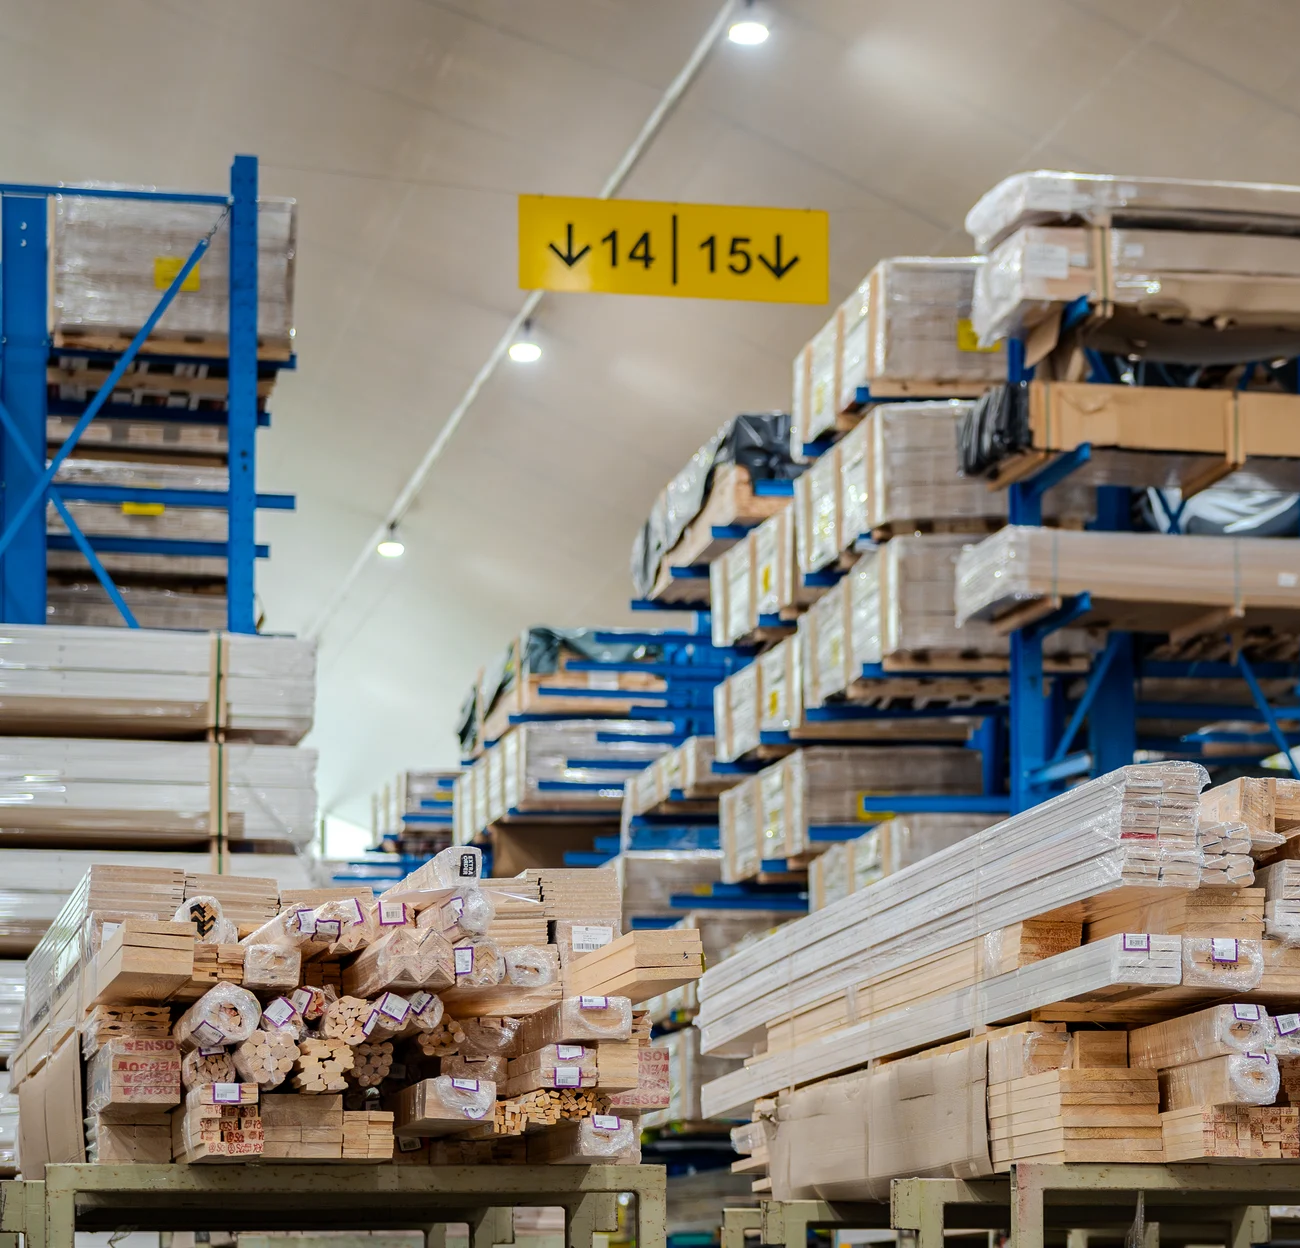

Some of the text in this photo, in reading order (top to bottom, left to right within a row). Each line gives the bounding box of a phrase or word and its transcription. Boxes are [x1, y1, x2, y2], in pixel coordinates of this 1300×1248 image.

[601, 229, 752, 275] 14 15
[135, 1040, 175, 1051] ENSO
